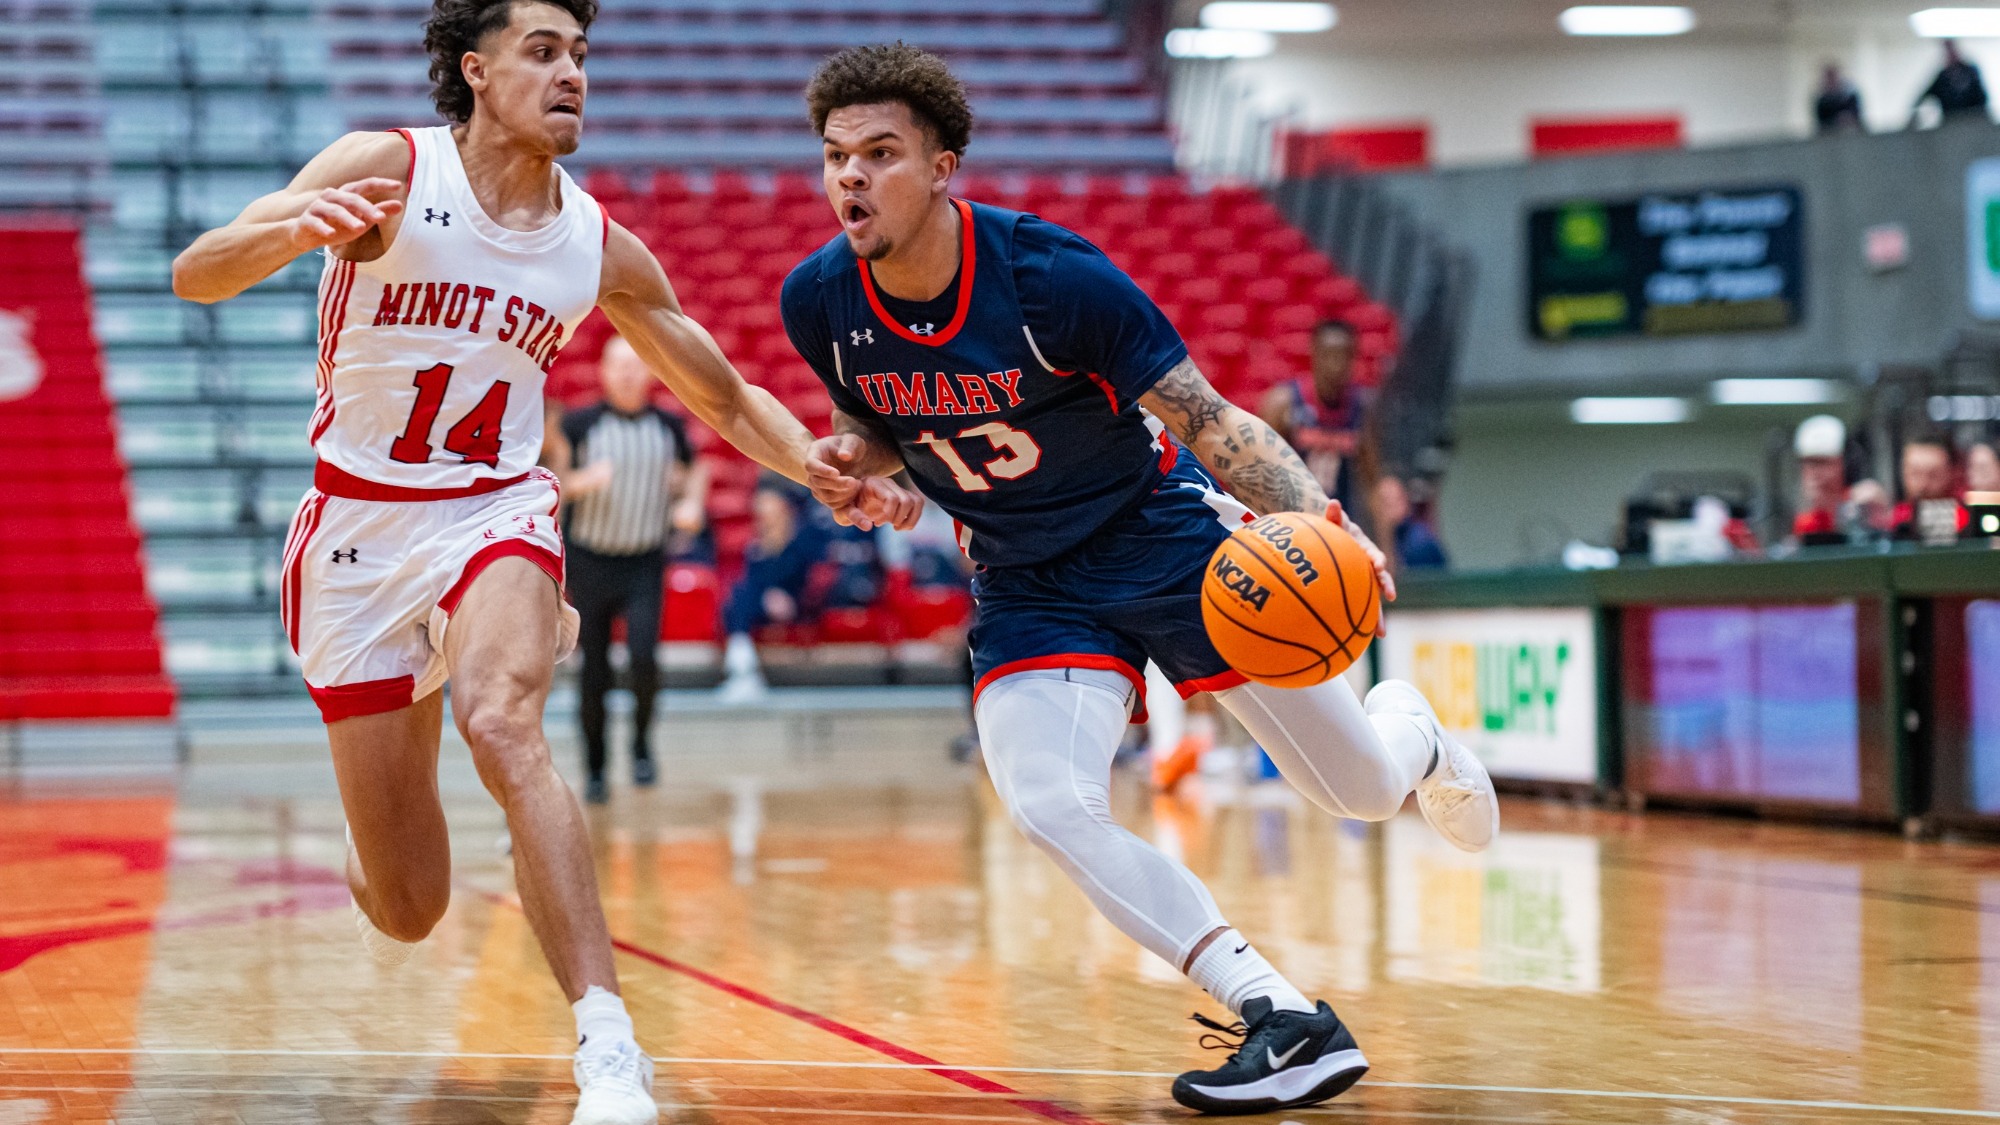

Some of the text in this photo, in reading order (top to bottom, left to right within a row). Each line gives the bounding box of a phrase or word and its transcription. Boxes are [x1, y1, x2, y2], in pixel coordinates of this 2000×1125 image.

[372, 282, 496, 334] MINOT
[389, 361, 512, 470] 14
[855, 367, 1026, 416] UMARY
[913, 420, 1043, 493] 13
[1212, 552, 1272, 614] NCAA
[1242, 515, 1320, 588] Wilson
